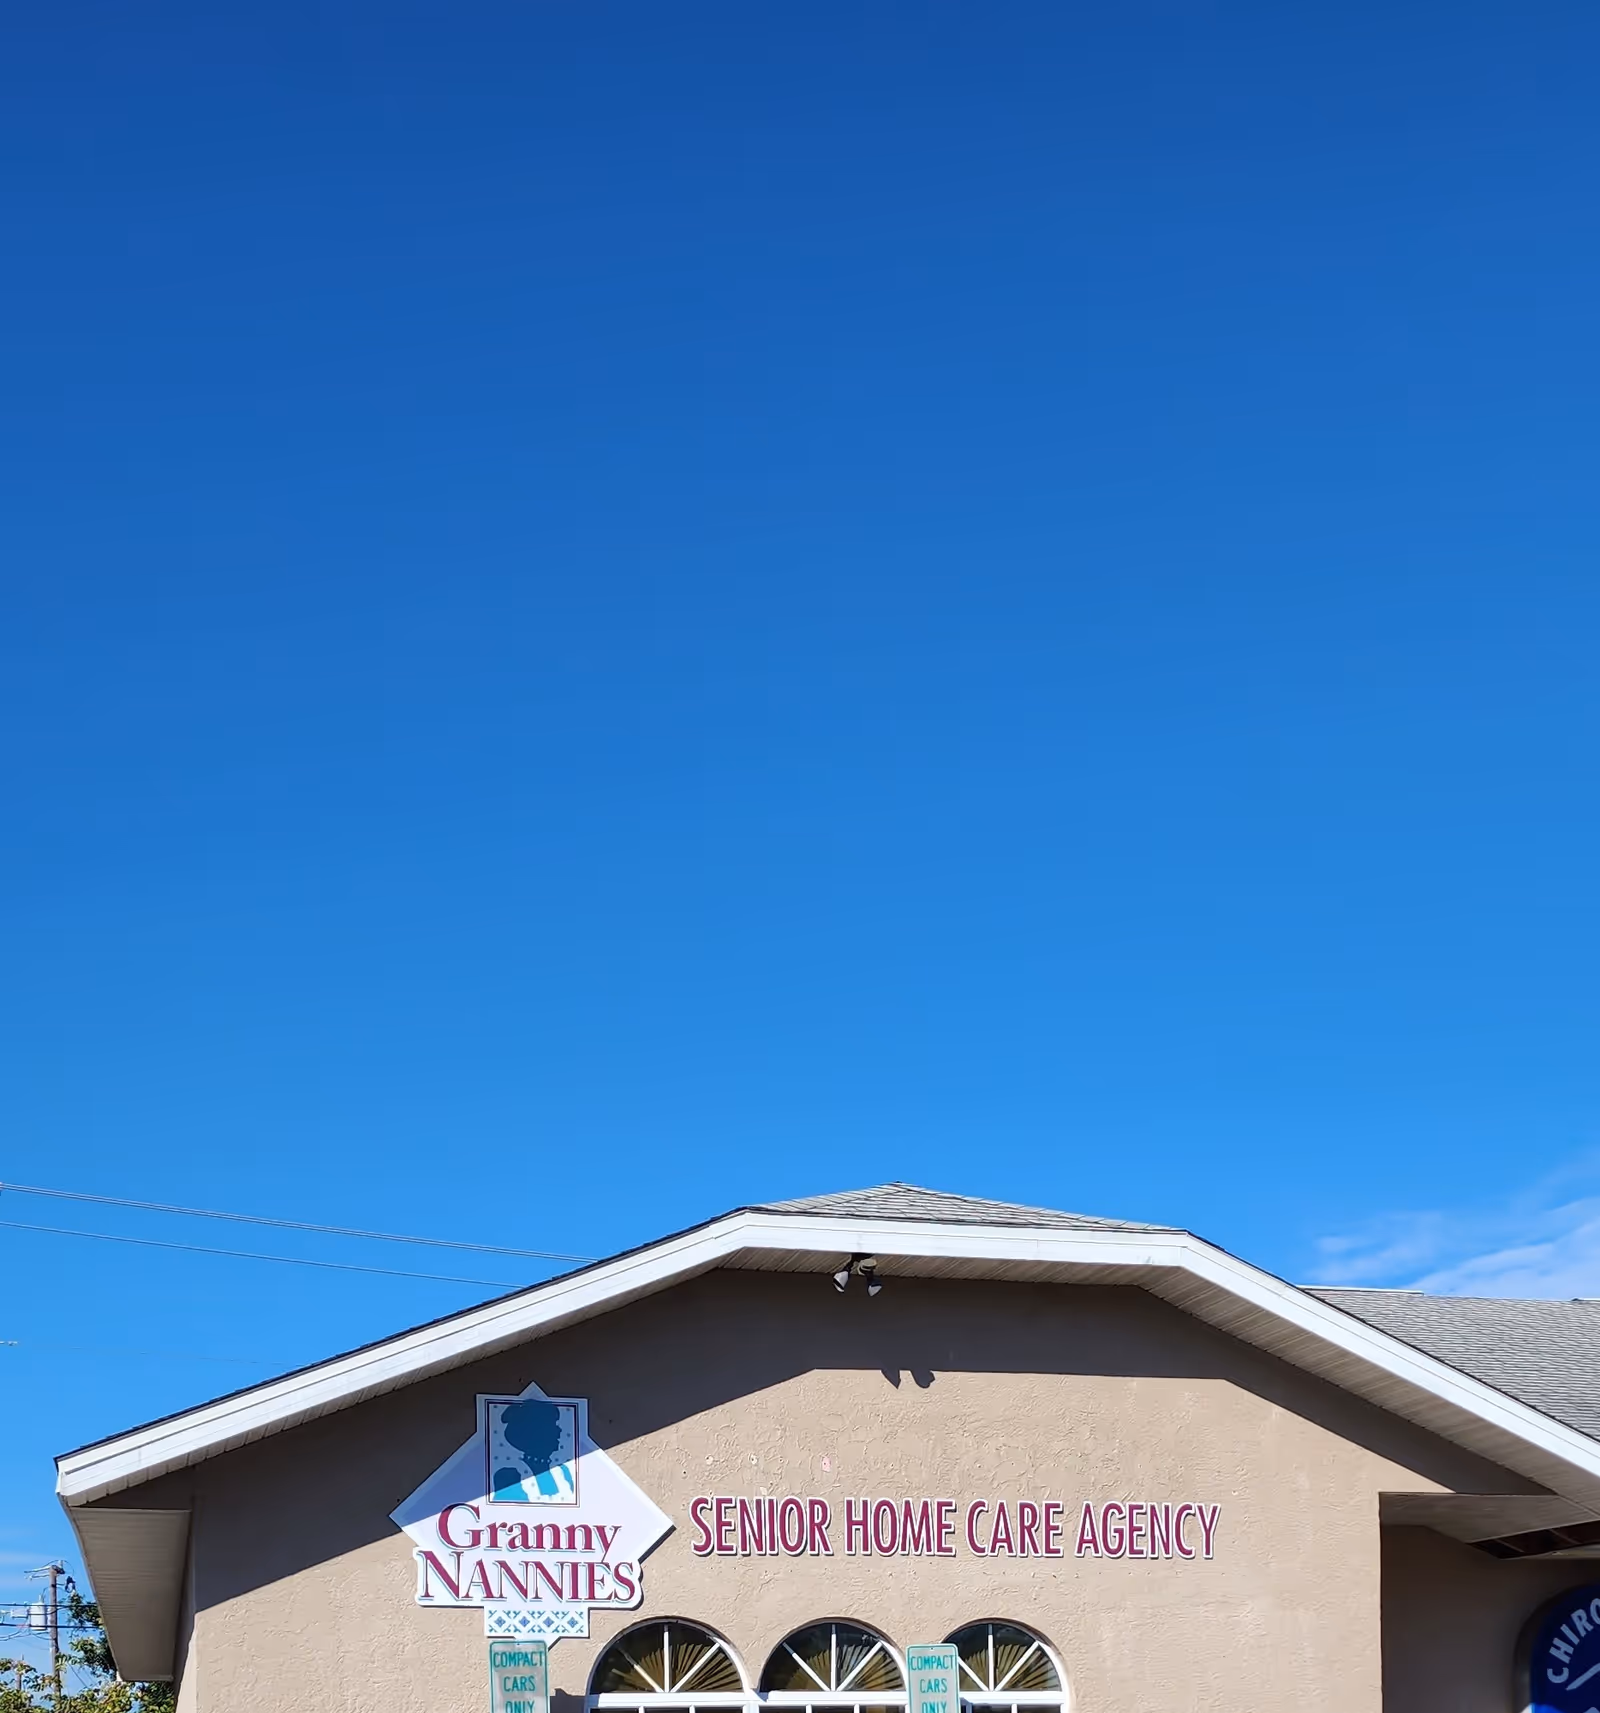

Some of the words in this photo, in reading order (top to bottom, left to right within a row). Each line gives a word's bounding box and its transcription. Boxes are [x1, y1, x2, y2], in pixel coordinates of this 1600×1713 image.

[436, 1503, 621, 1562] Granny
[689, 1496, 829, 1555] SENIOR
[845, 1498, 955, 1555] HOME
[966, 1499, 1062, 1556] CARE
[1075, 1502, 1219, 1557] AGENCY
[417, 1550, 636, 1602] NANNIES
[493, 1651, 544, 1668] COMPACT
[910, 1655, 954, 1671] COMPACT
[503, 1675, 536, 1692] CARS
[919, 1678, 948, 1693] CARS
